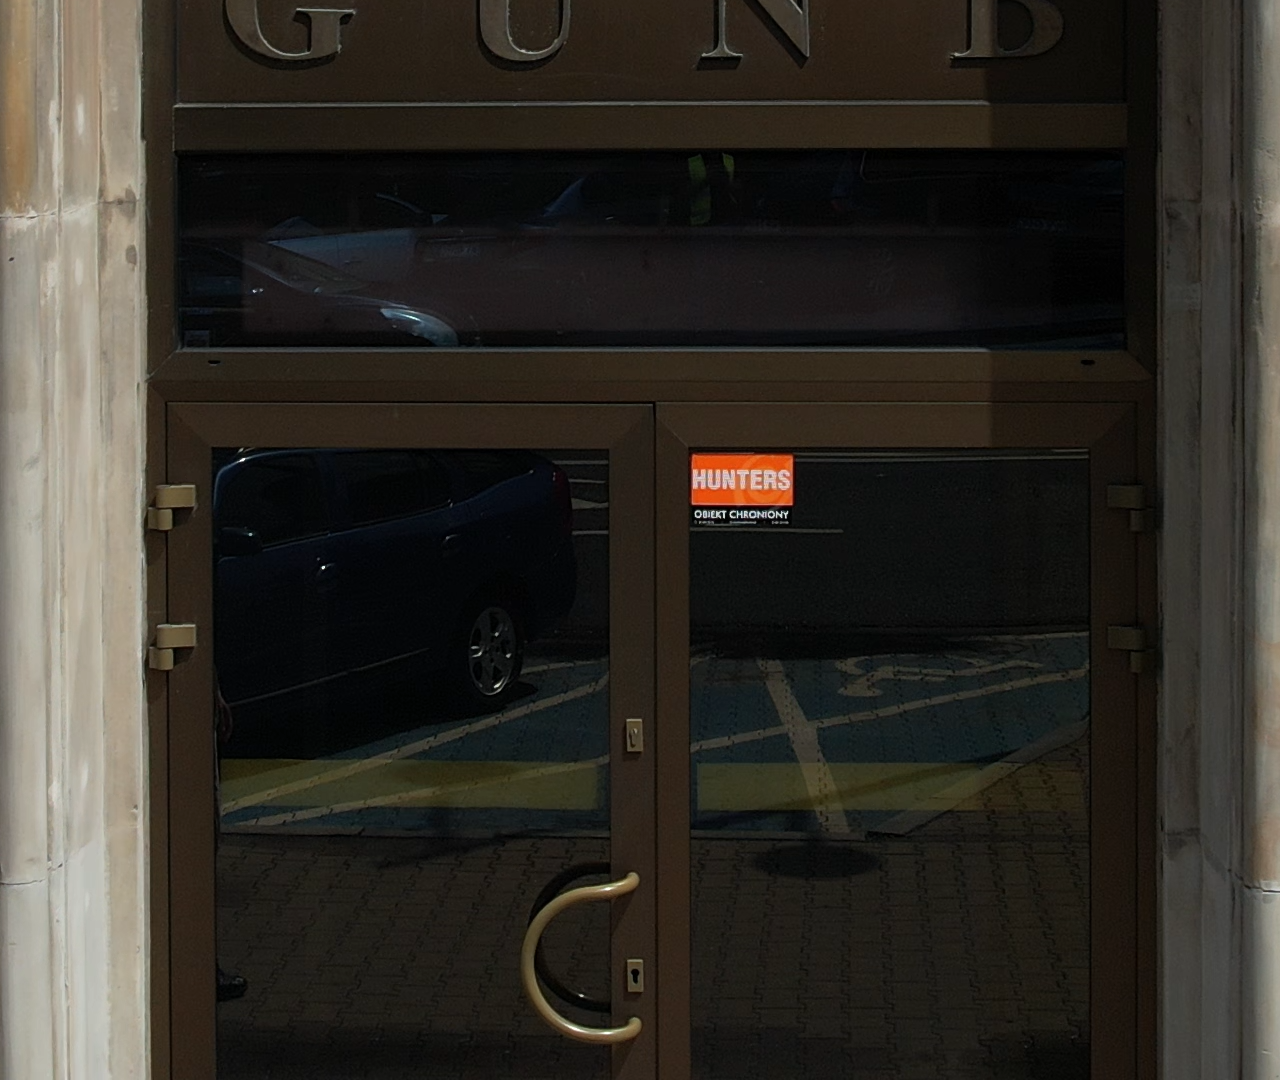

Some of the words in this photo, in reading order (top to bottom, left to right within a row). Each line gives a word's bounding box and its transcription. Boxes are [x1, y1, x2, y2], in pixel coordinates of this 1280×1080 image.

[692, 469, 791, 490] HUNTERS
[694, 510, 727, 519] OBIEKT
[729, 510, 789, 519] CHRONIONY
